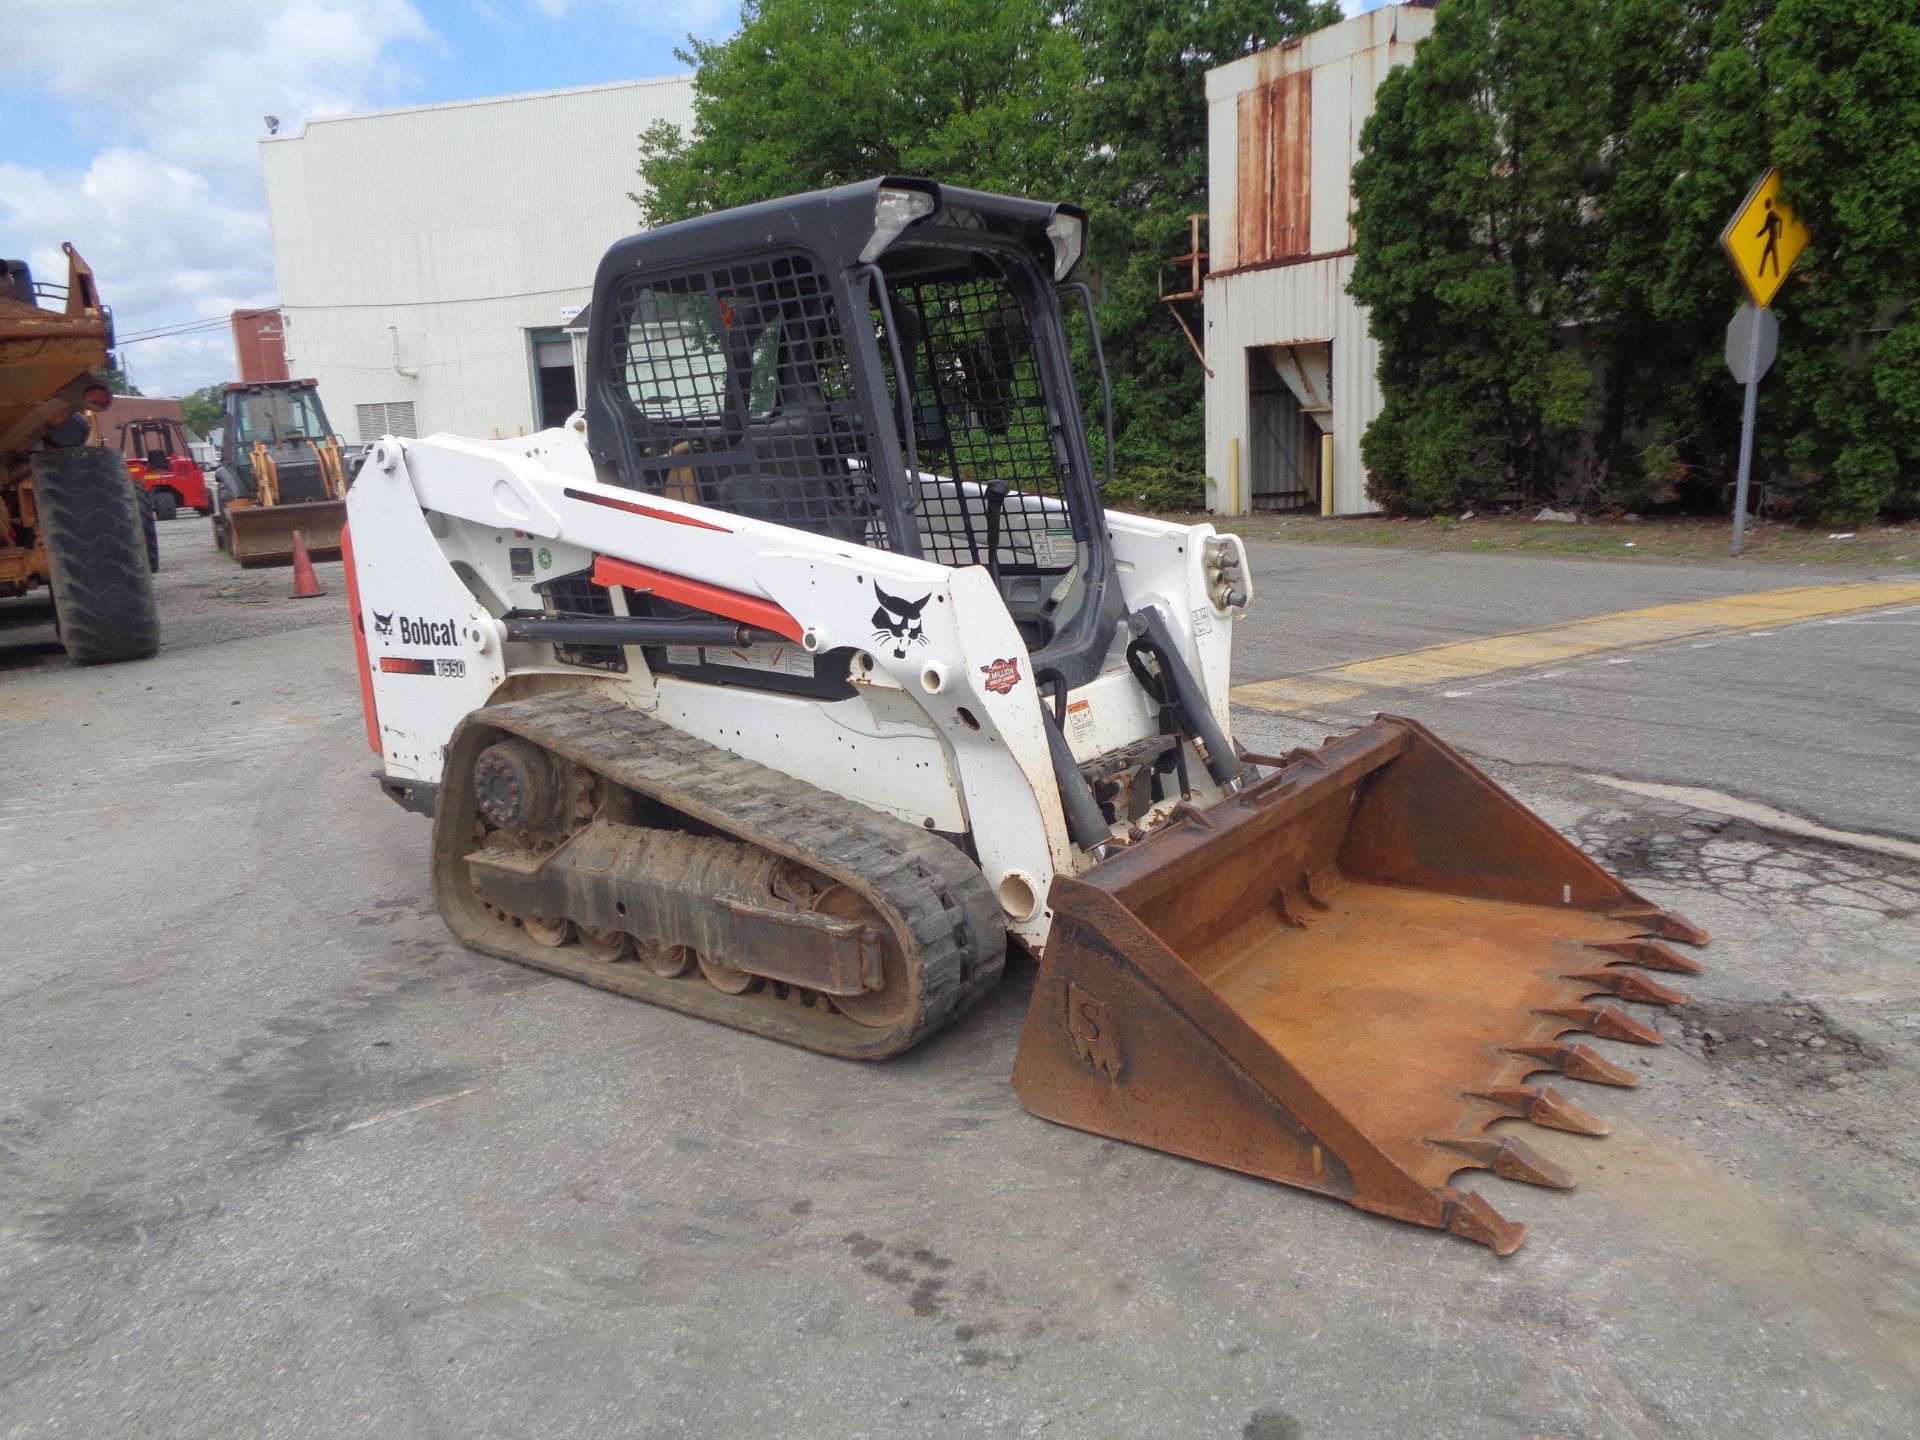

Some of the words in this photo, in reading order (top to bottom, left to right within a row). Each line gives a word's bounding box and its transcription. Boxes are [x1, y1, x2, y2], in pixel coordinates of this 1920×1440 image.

[400, 616, 458, 646] Bobcat
[437, 659, 466, 678] T550
[1079, 1003, 1100, 1041] S
